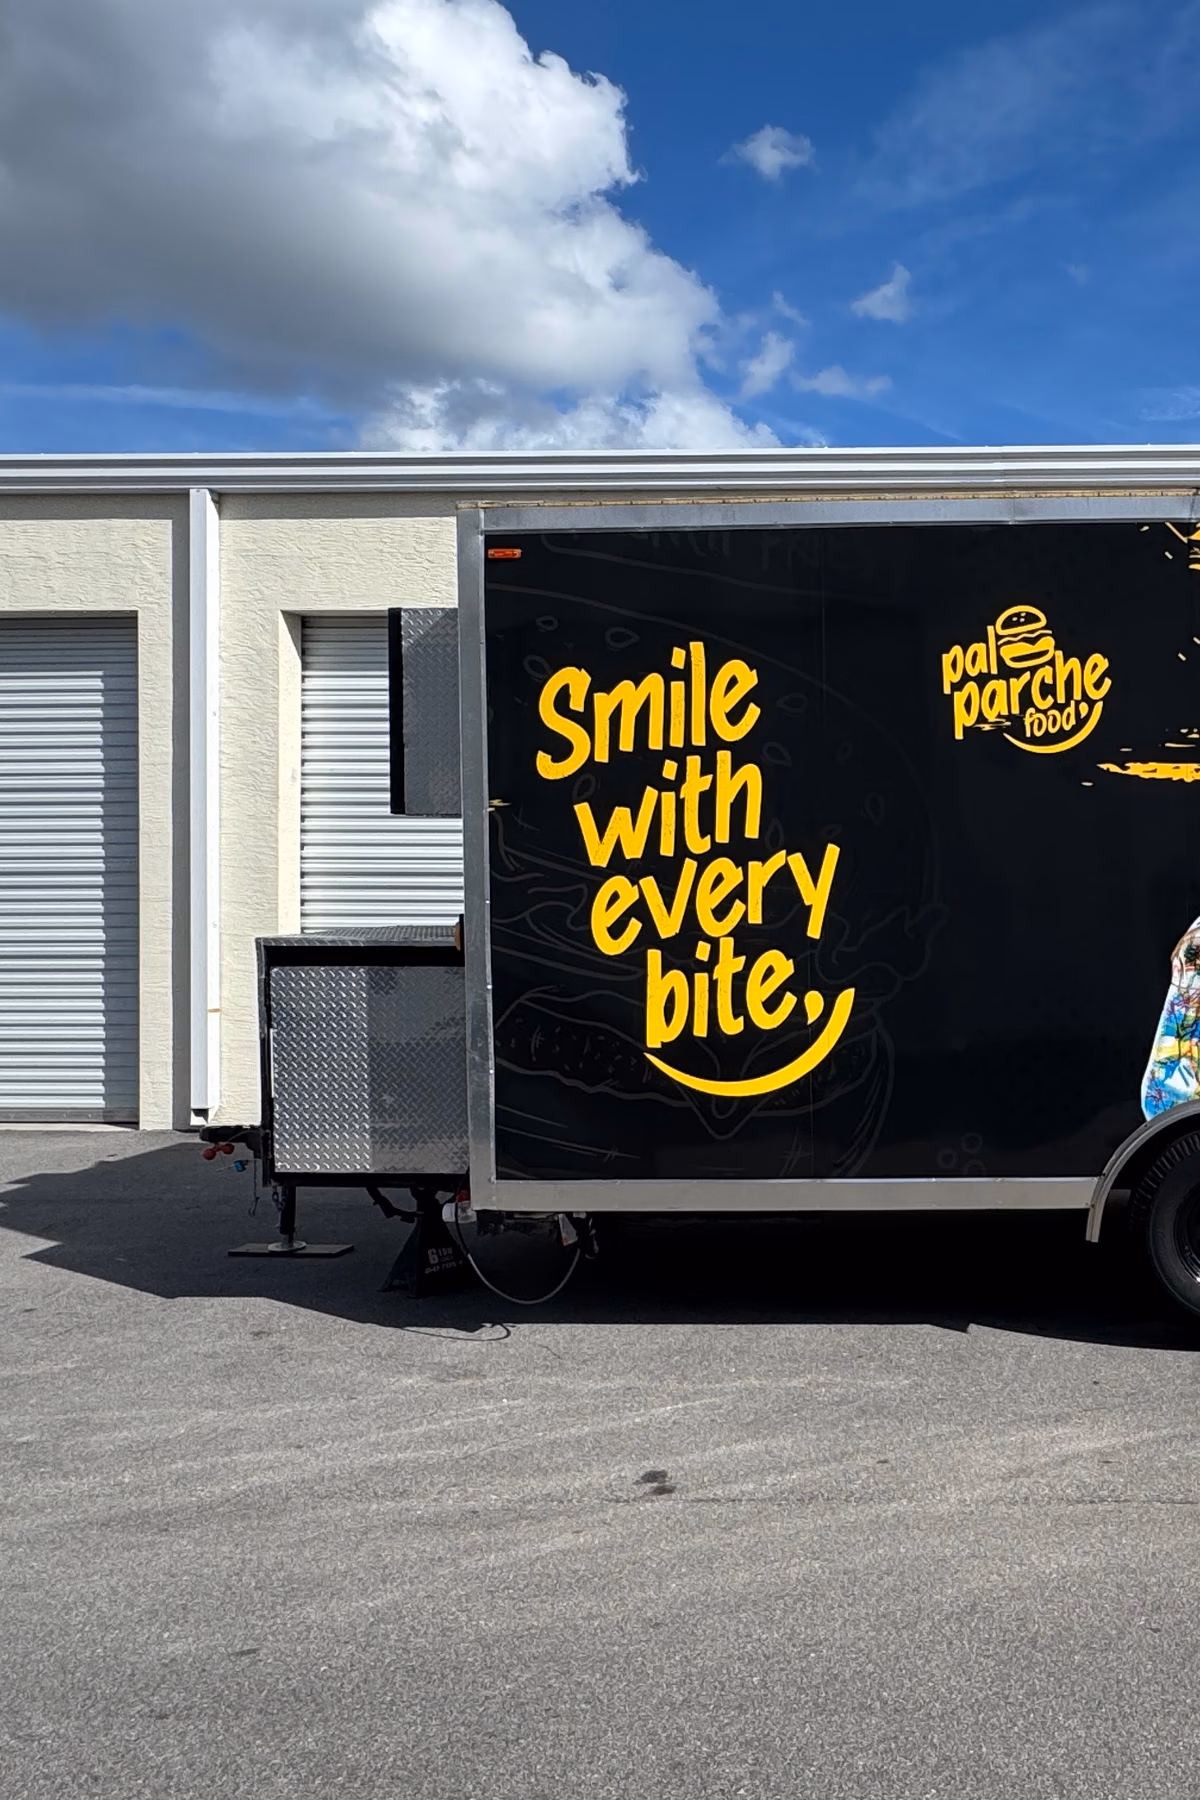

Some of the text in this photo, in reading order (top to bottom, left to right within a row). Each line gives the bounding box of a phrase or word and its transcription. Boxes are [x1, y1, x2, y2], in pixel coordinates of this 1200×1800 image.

[941, 624, 998, 695] pal
[953, 650, 1113, 741] parche
[535, 641, 761, 780] Smile
[573, 750, 763, 868] with
[590, 845, 841, 956] every
[427, 1248, 439, 1265] 6
